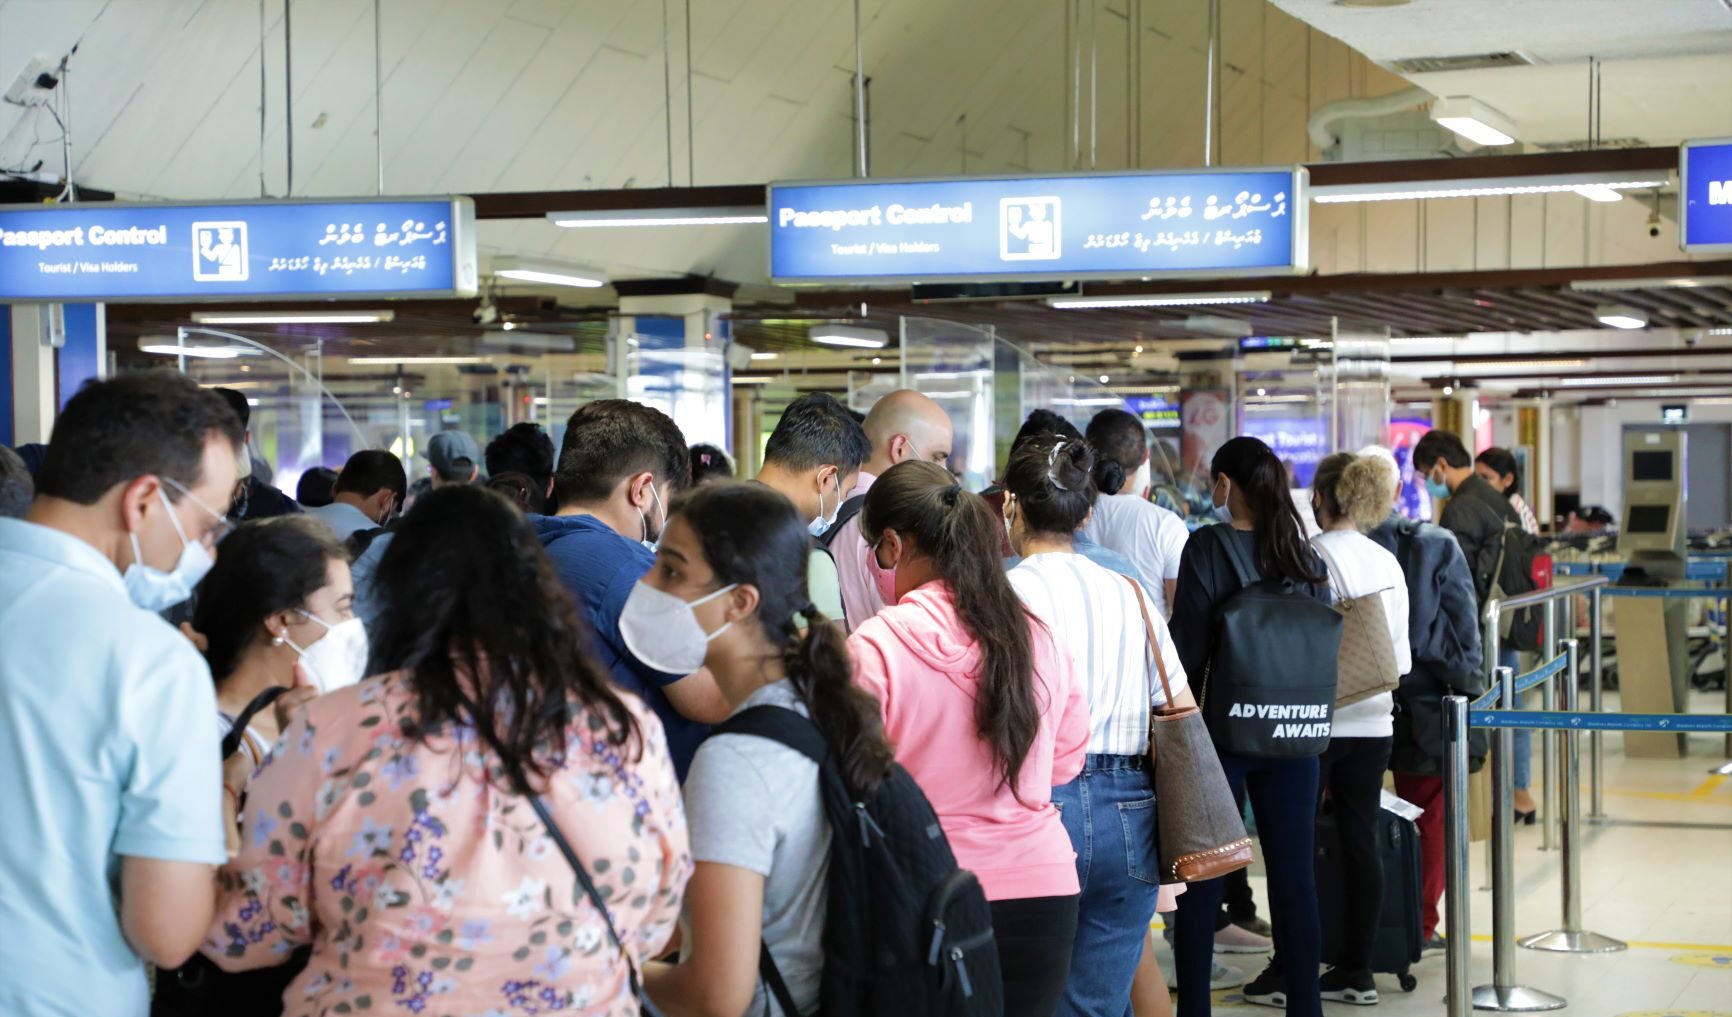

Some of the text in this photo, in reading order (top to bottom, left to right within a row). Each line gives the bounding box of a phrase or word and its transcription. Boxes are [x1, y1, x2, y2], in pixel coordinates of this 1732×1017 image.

[779, 202, 973, 231] Passport Control
[0, 224, 168, 250] assport Control
[831, 243, 868, 256] Tourist
[876, 243, 898, 255] Visa
[899, 241, 941, 254] Holders
[38, 262, 71, 274] Tourist
[79, 262, 99, 273] Visa
[101, 261, 138, 273] Holders
[1229, 703, 1329, 719] ADVENTURE
[1272, 722, 1331, 738] AWAITS
